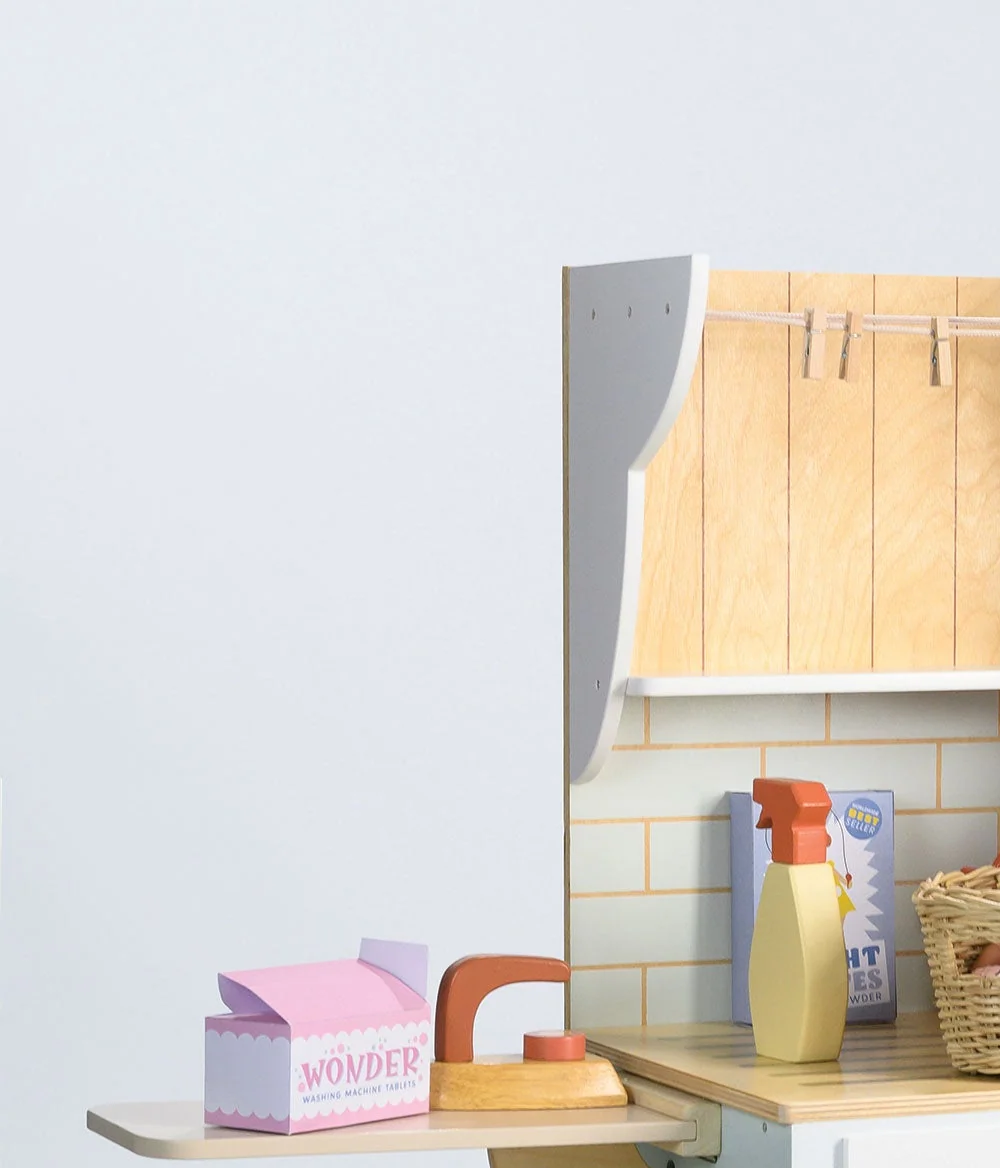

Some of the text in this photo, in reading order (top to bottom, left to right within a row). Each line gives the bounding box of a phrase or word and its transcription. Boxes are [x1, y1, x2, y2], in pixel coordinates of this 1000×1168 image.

[845, 818, 875, 835] SELLER
[846, 945, 880, 968] HT
[848, 968, 882, 991] ES
[849, 992, 882, 1004] WDER
[301, 1046, 421, 1091] WONDER
[302, 1080, 417, 1104] WASHING MACHINE TABLETS
